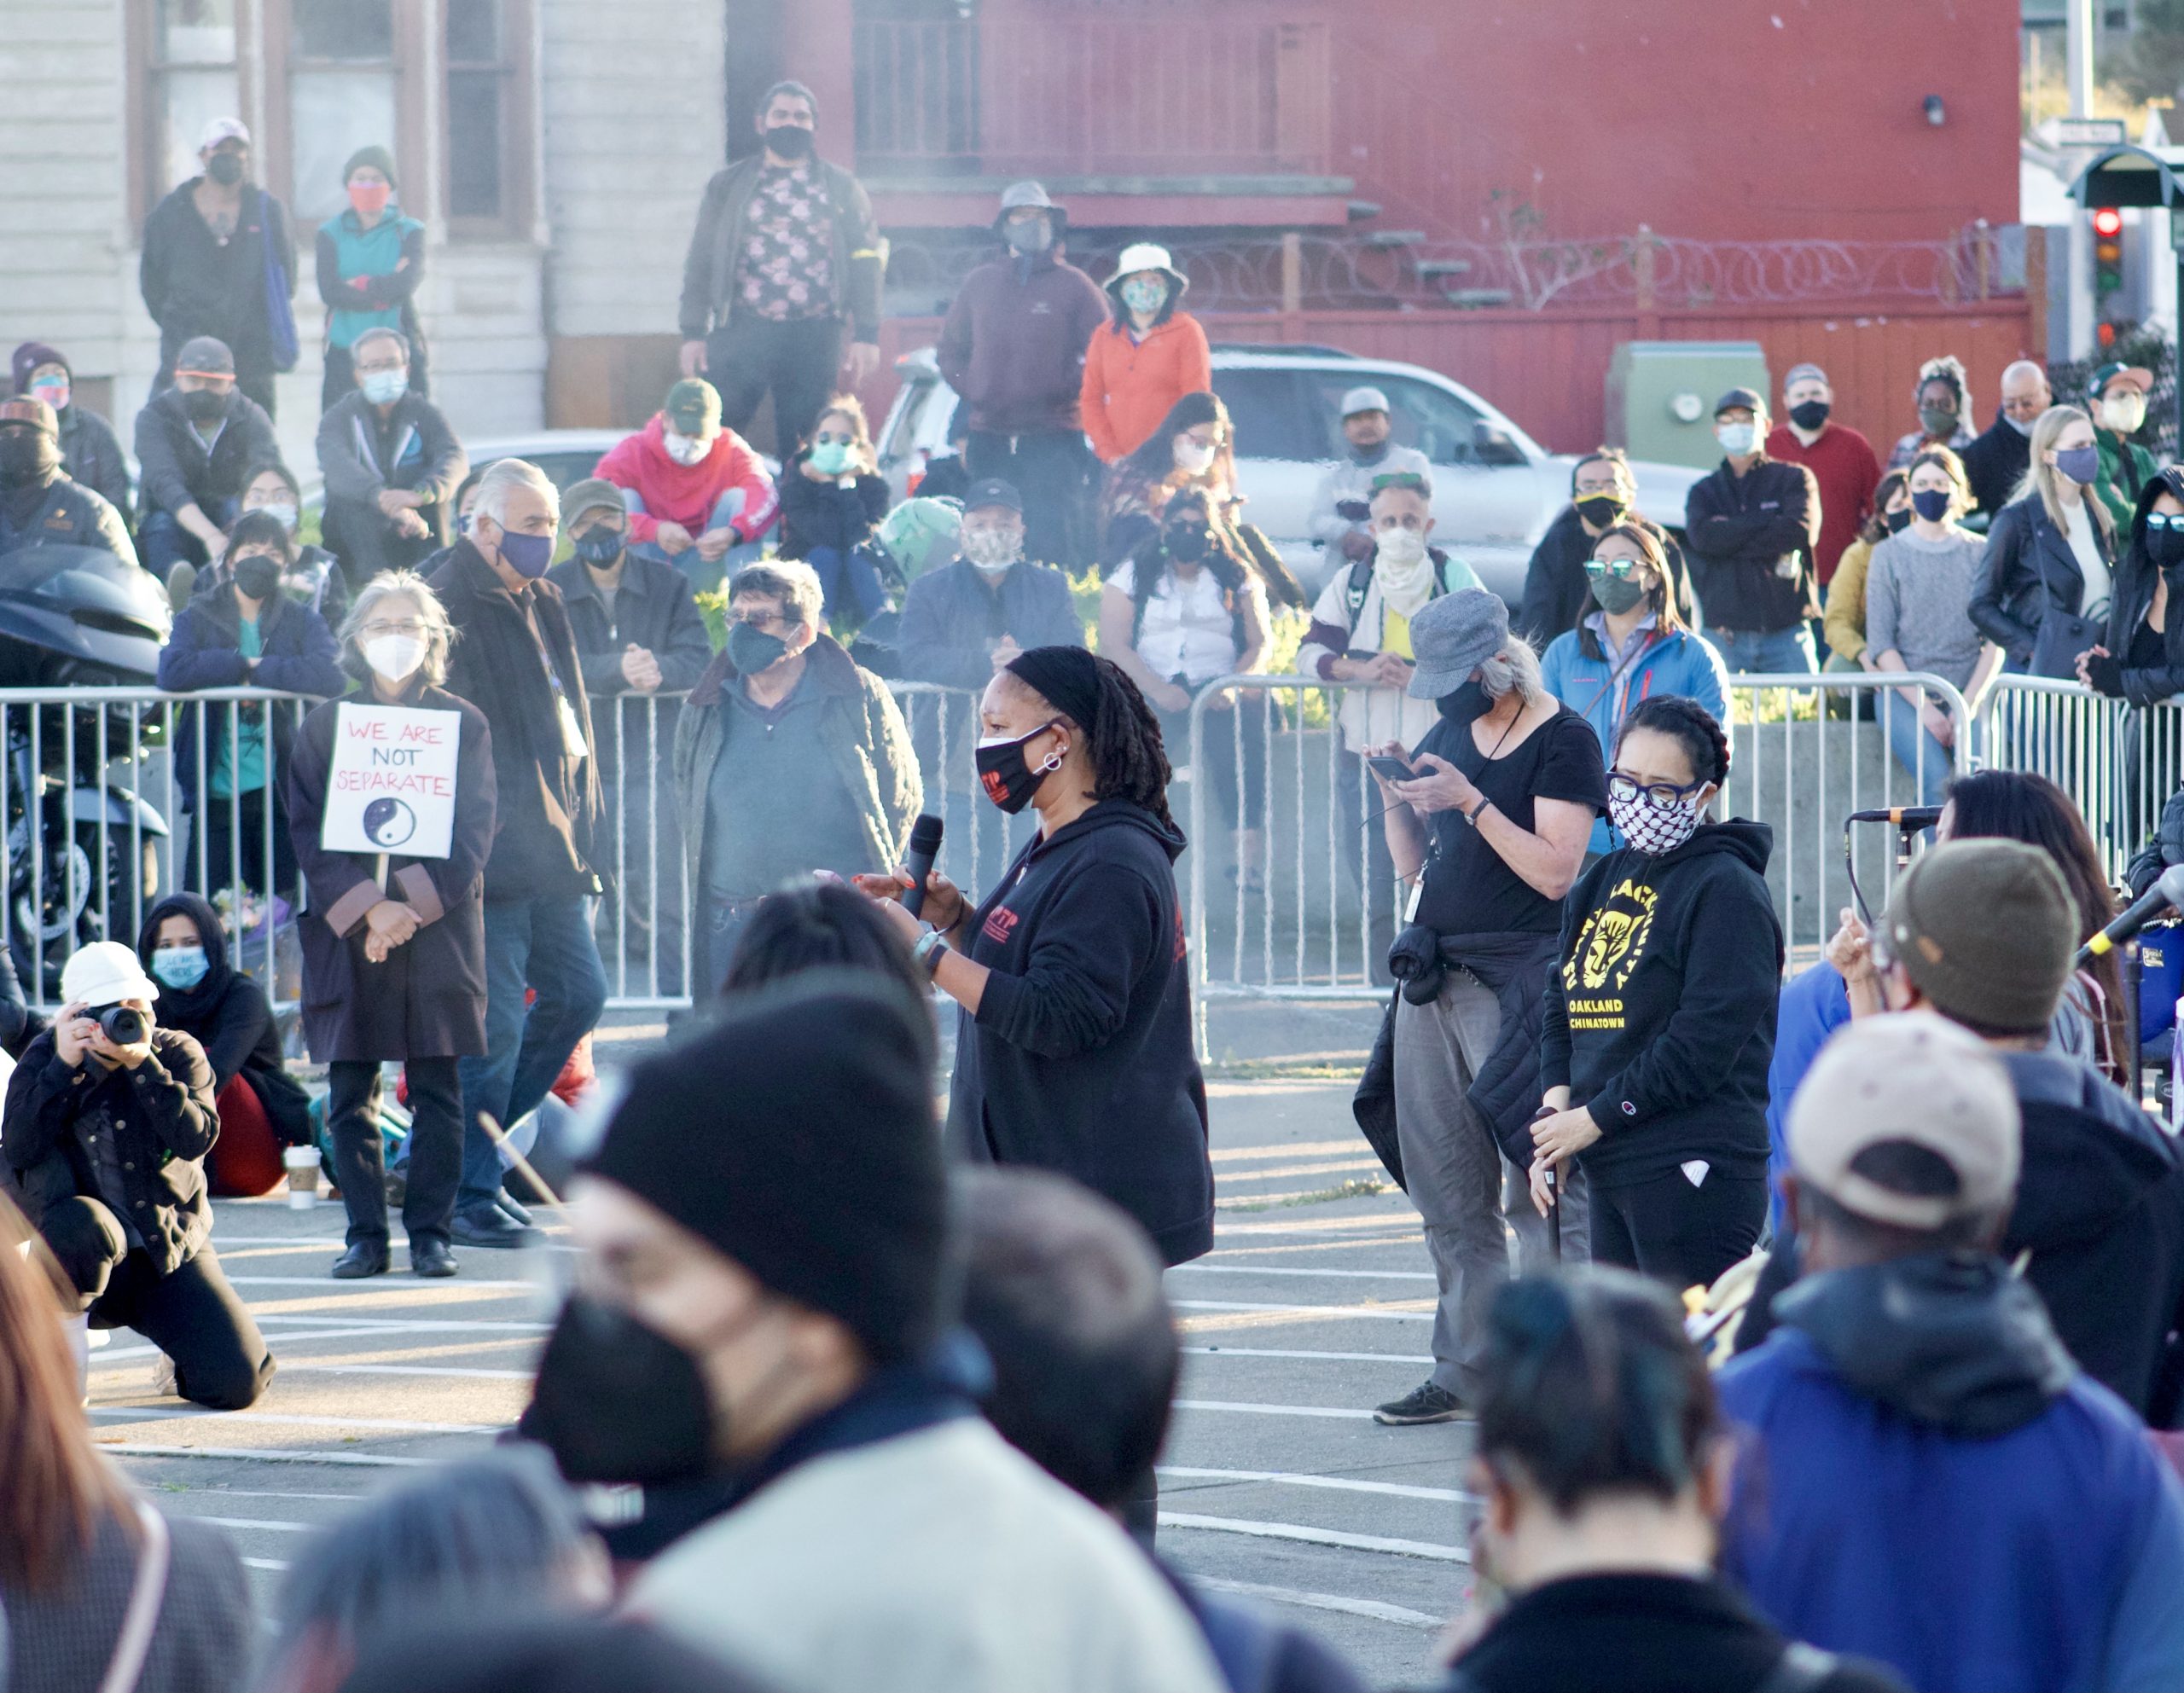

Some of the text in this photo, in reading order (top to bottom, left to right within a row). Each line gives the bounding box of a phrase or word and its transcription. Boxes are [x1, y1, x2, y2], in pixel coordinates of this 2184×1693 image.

[349, 722, 443, 745] WE ARE
[373, 747, 423, 766] NOT
[337, 770, 451, 797] SEPARATE
[1606, 879, 1658, 912] LACK
[1569, 999, 1623, 1013] OAKLAND
[1570, 1017, 1625, 1029] CHINATOWN
